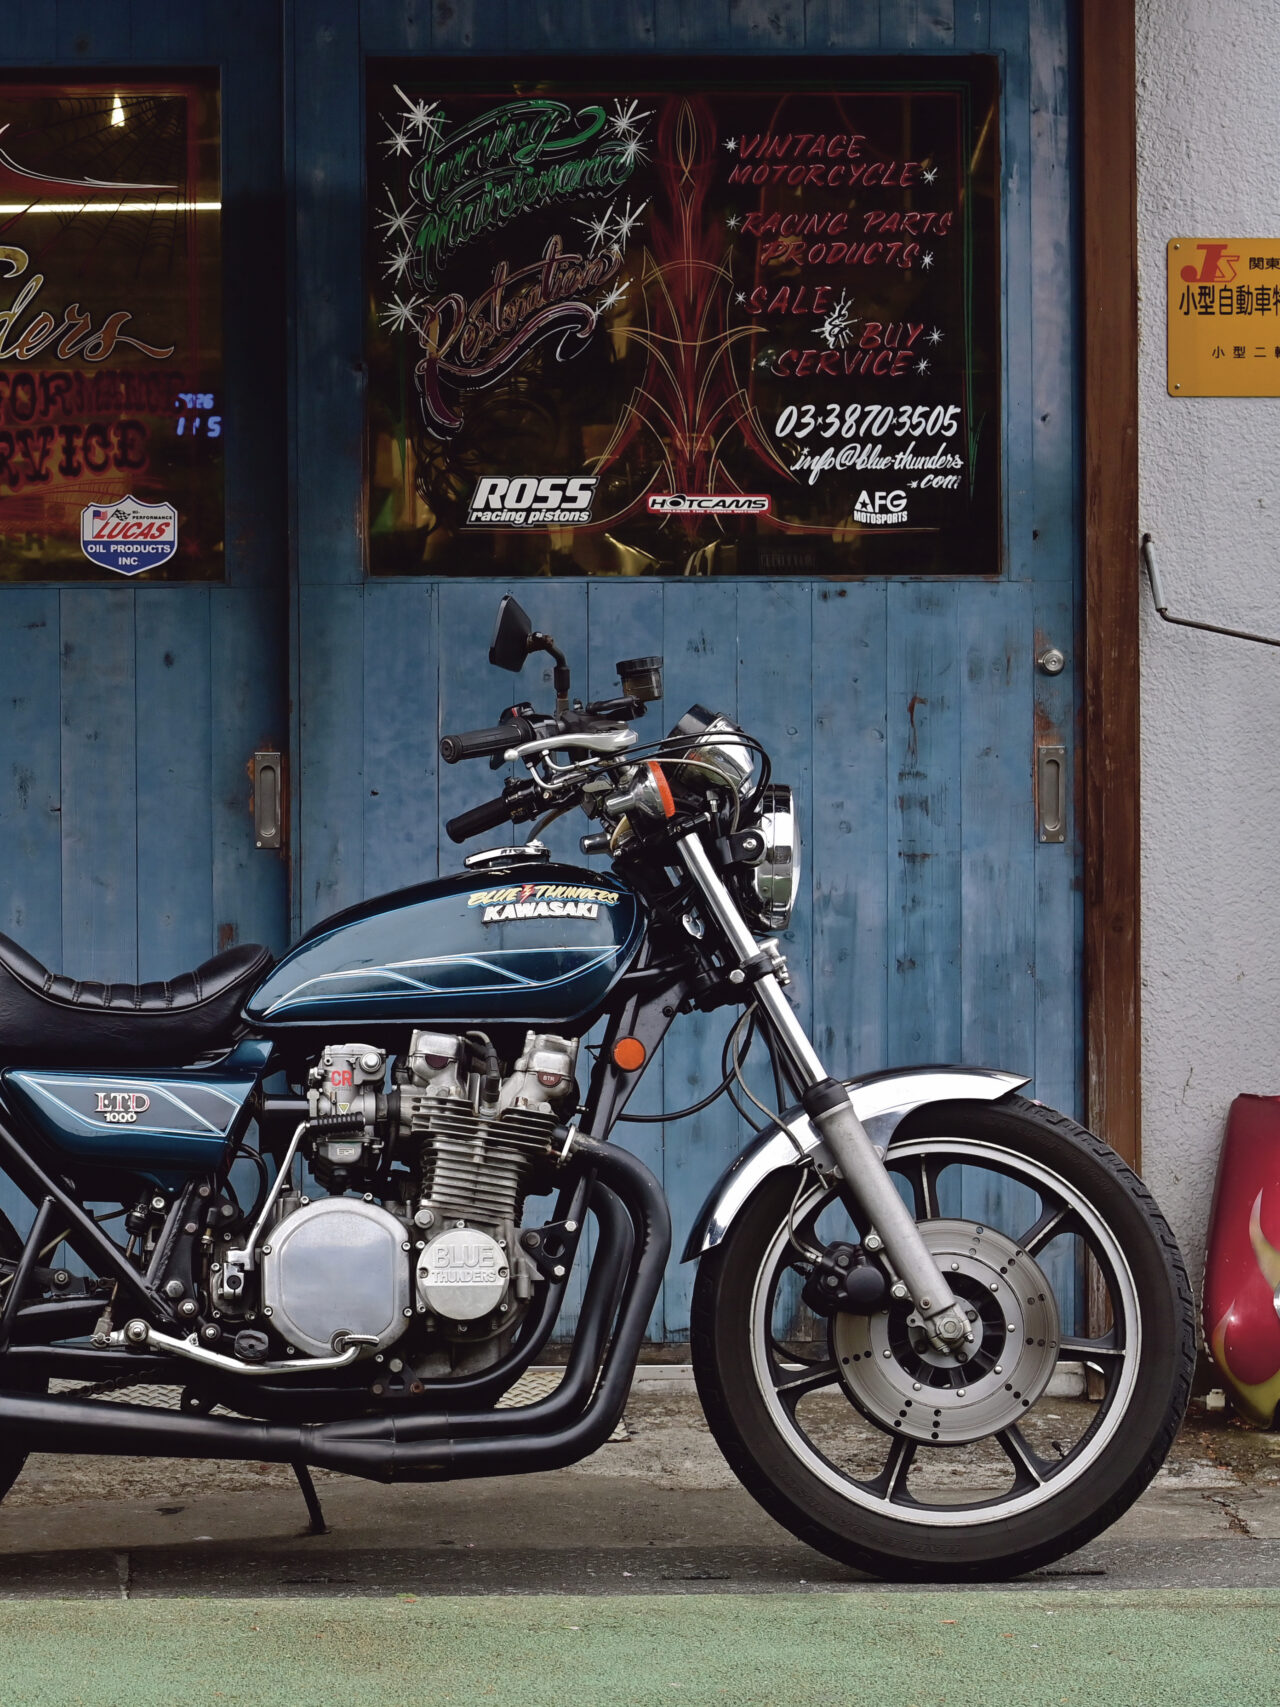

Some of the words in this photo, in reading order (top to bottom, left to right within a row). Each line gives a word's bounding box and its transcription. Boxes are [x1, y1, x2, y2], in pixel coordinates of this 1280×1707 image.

[740, 134, 866, 159] VINTAGE
[729, 161, 921, 187] MOTORCYCLE
[740, 211, 848, 236] RACING
[863, 211, 953, 236] PARTS
[760, 242, 920, 268] PRODUCTS
[746, 286, 832, 314] SALE
[859, 322, 924, 349] BUY
[771, 349, 914, 377] SERVICE
[472, 477, 597, 509] ROSS
[650, 495, 767, 509] HOTCAMS
[854, 490, 907, 512] AFG
[470, 510, 525, 524] racing
[527, 509, 591, 524] pistons
[853, 510, 908, 525] MOTOSPORTS
[92, 522, 170, 539] LUCAS
[88, 545, 106, 553] OIL
[110, 545, 170, 553] PRODUCTS
[119, 557, 138, 565] INC
[467, 887, 523, 906] BLUE
[533, 884, 619, 905] THUNDERS
[483, 901, 599, 921] KAWASAKI
[331, 1070, 353, 1086] CR
[94, 1092, 151, 1112] LTD
[104, 1111, 137, 1123] 1000
[433, 1244, 496, 1268] BLUE
[431, 1271, 497, 1283] THUNDERS
